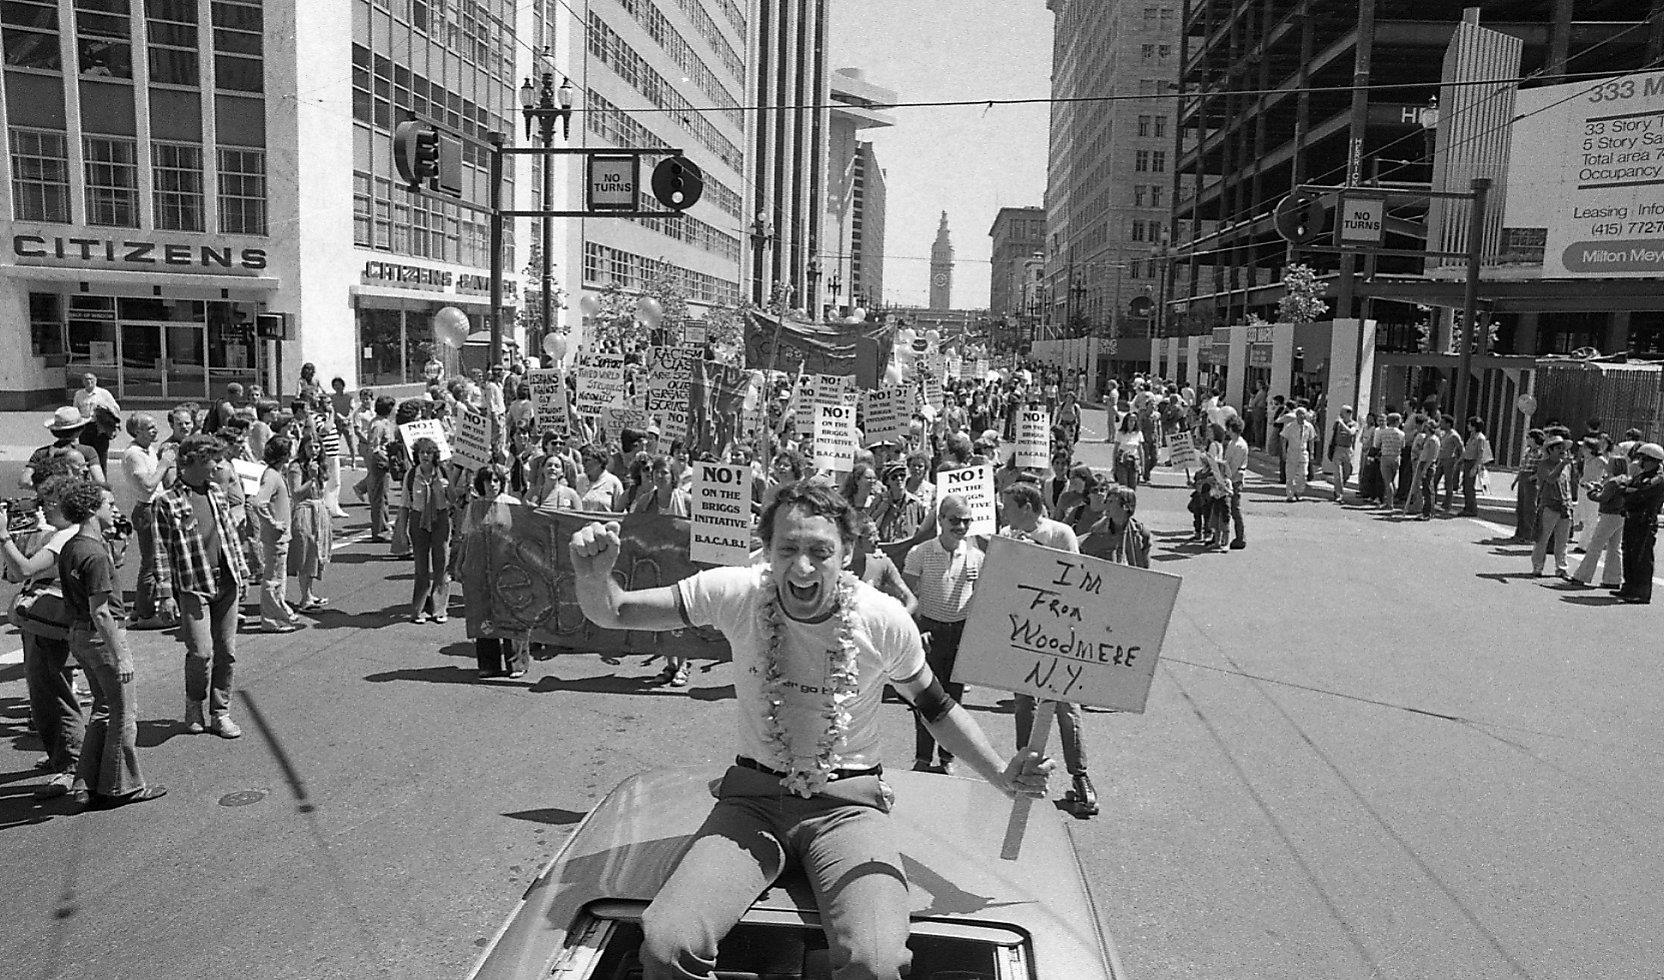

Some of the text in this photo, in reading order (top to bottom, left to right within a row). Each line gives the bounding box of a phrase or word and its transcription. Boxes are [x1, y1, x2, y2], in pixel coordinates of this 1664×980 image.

[1588, 79, 1635, 103] 333
[1584, 122, 1605, 136] 33
[1612, 120, 1652, 133] Story
[1583, 138, 1593, 151] 5
[1598, 137, 1638, 150] Story
[1582, 152, 1614, 166] Total
[1617, 151, 1650, 163] area
[604, 173, 620, 183] NO
[1579, 165, 1663, 181] Occupancy
[594, 183, 632, 193] TURNS
[1354, 211, 1370, 221] NO
[1574, 205, 1628, 220] Leasing
[1345, 220, 1380, 231] TURNS
[1591, 222, 1623, 236] (415)
[13, 234, 267, 270] CITIZENS
[1582, 248, 1664, 263] Milton Mey
[365, 260, 452, 288] CITIZENS
[661, 359, 692, 372] CLAS
[820, 376, 841, 386] NO!
[800, 388, 814, 397] NO
[869, 390, 891, 402] NO!
[895, 388, 907, 398] O!
[668, 412, 688, 425] NO!
[822, 406, 850, 419] NO!
[1023, 412, 1045, 423] NO!
[407, 421, 434, 431] NO!
[464, 412, 486, 428] NO!
[1170, 433, 1189, 443] NO!
[703, 466, 742, 486] NO!
[948, 467, 984, 484] NO!
[701, 488, 741, 501] ON THE
[965, 484, 984, 492] THE
[701, 502, 741, 514] BRIGGS
[694, 514, 748, 529] INITIATIVE
[694, 534, 747, 549] B.A.C.A.B.I.
[1024, 657, 1083, 696] N.Y.
[800, 684, 818, 694] go
